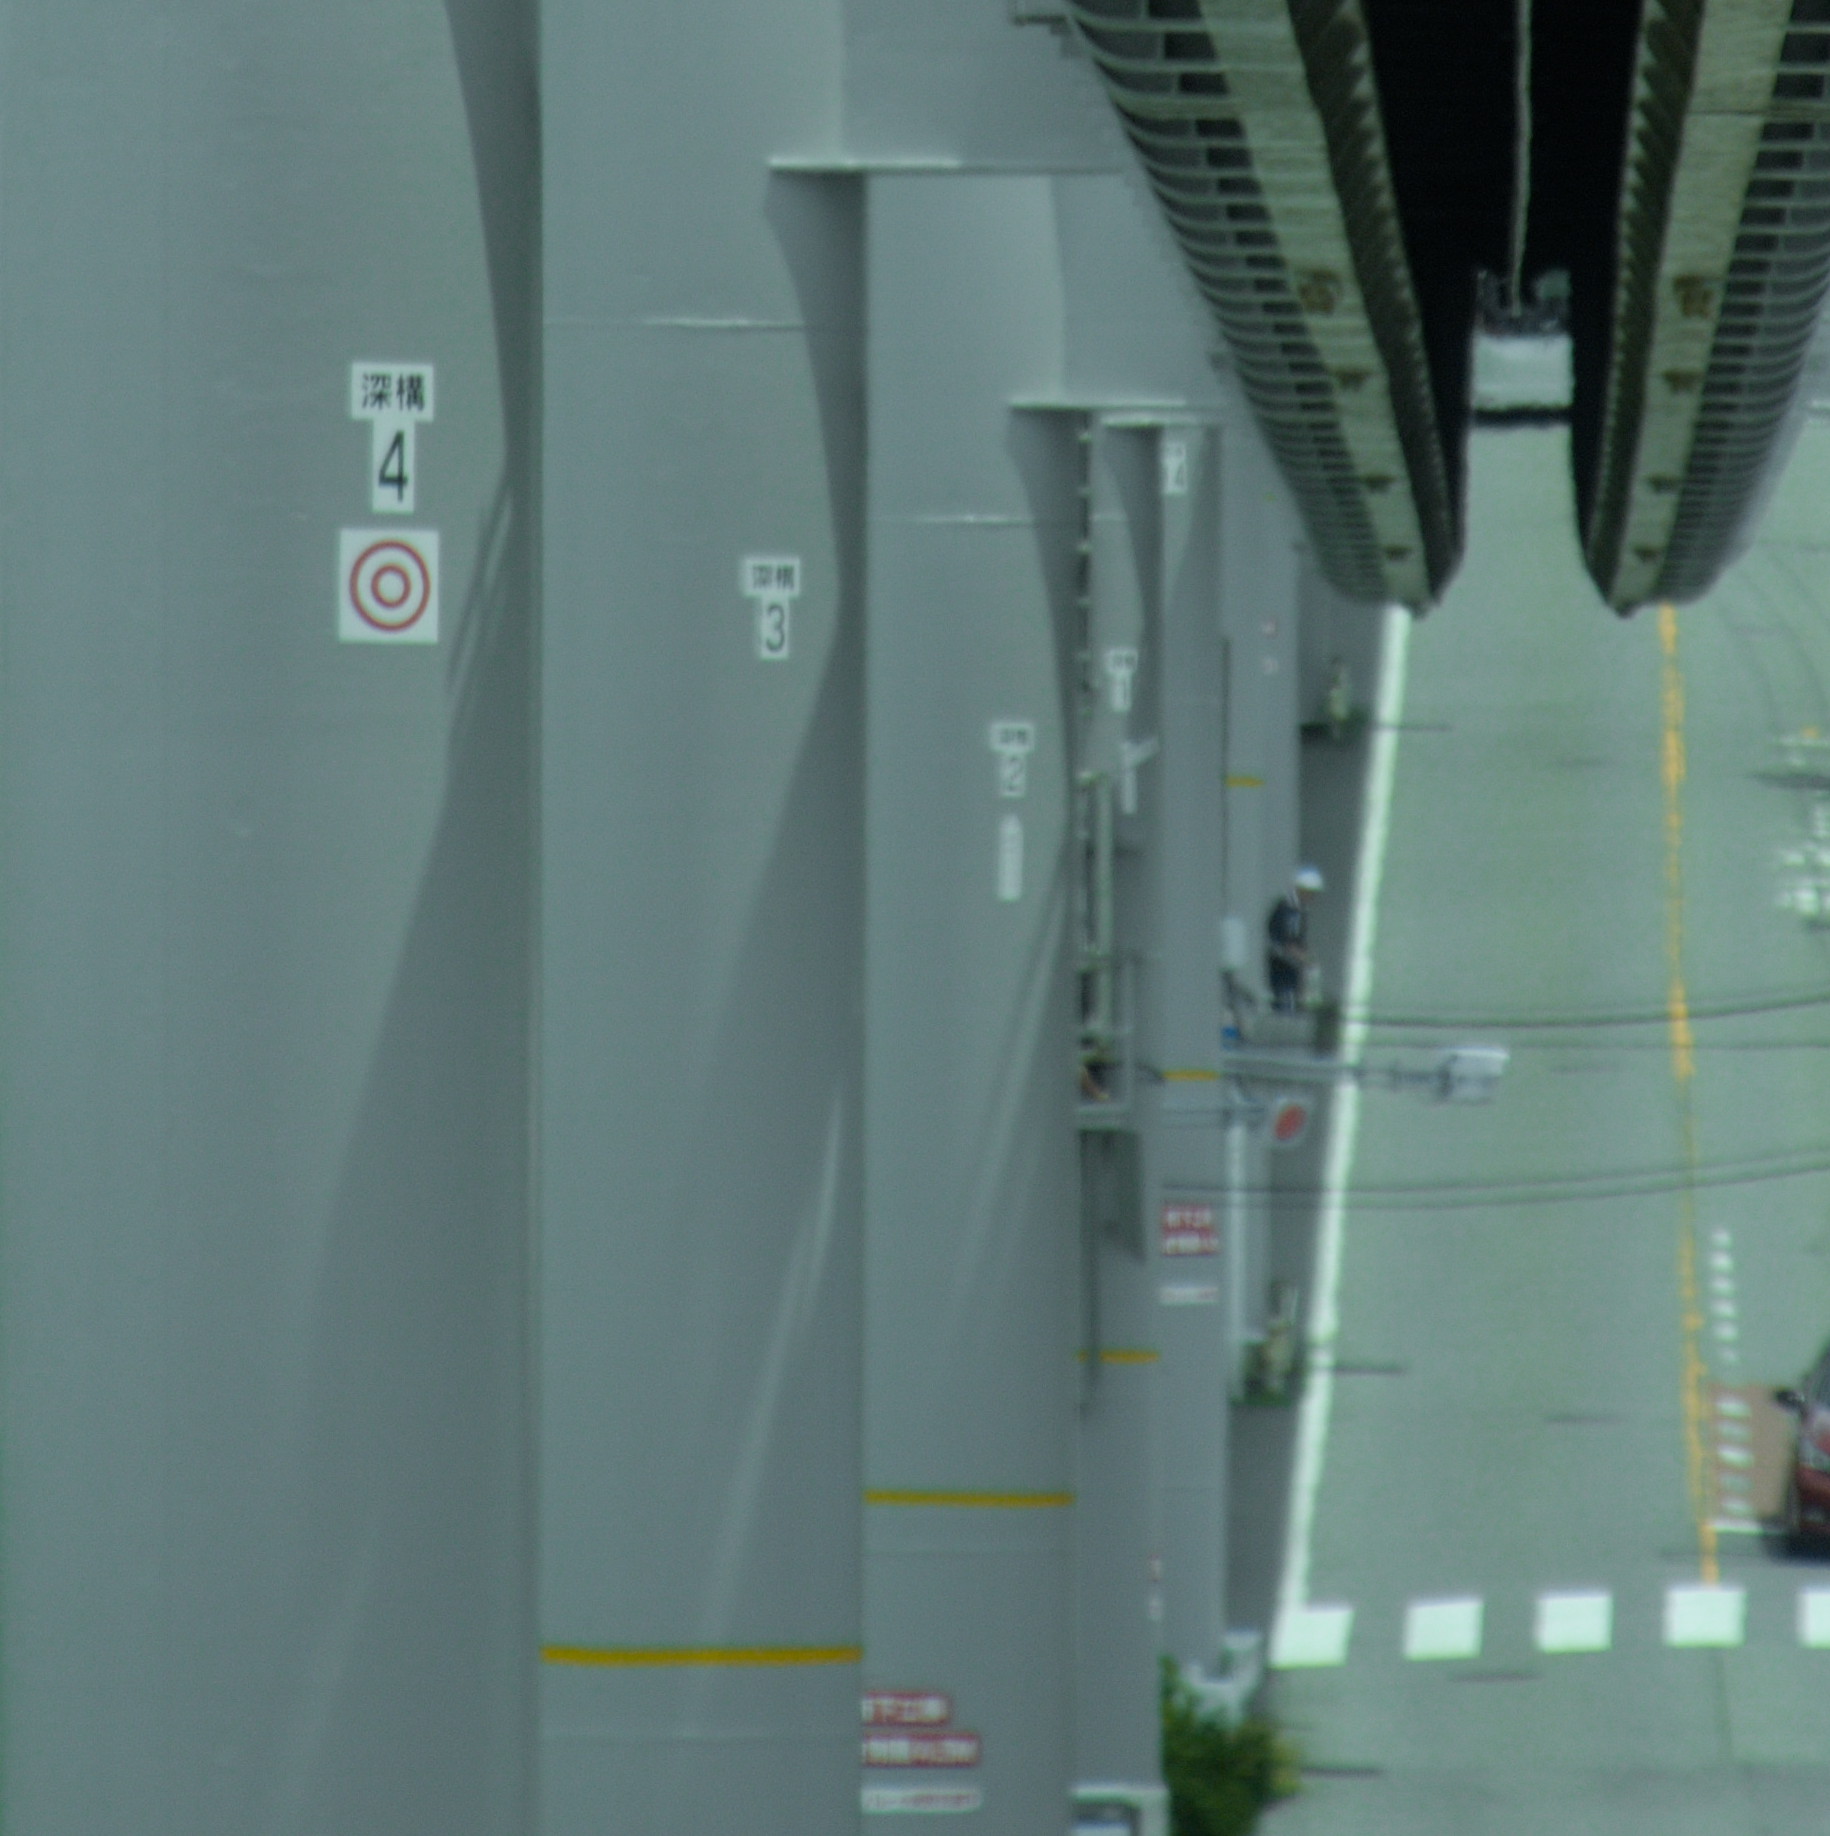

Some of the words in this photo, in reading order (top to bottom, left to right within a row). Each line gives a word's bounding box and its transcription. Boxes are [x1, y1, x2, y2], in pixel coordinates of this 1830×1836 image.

[362, 372, 425, 412] 深構
[378, 429, 409, 504] 4
[766, 604, 785, 653] 3
[1006, 754, 1024, 794] 2
